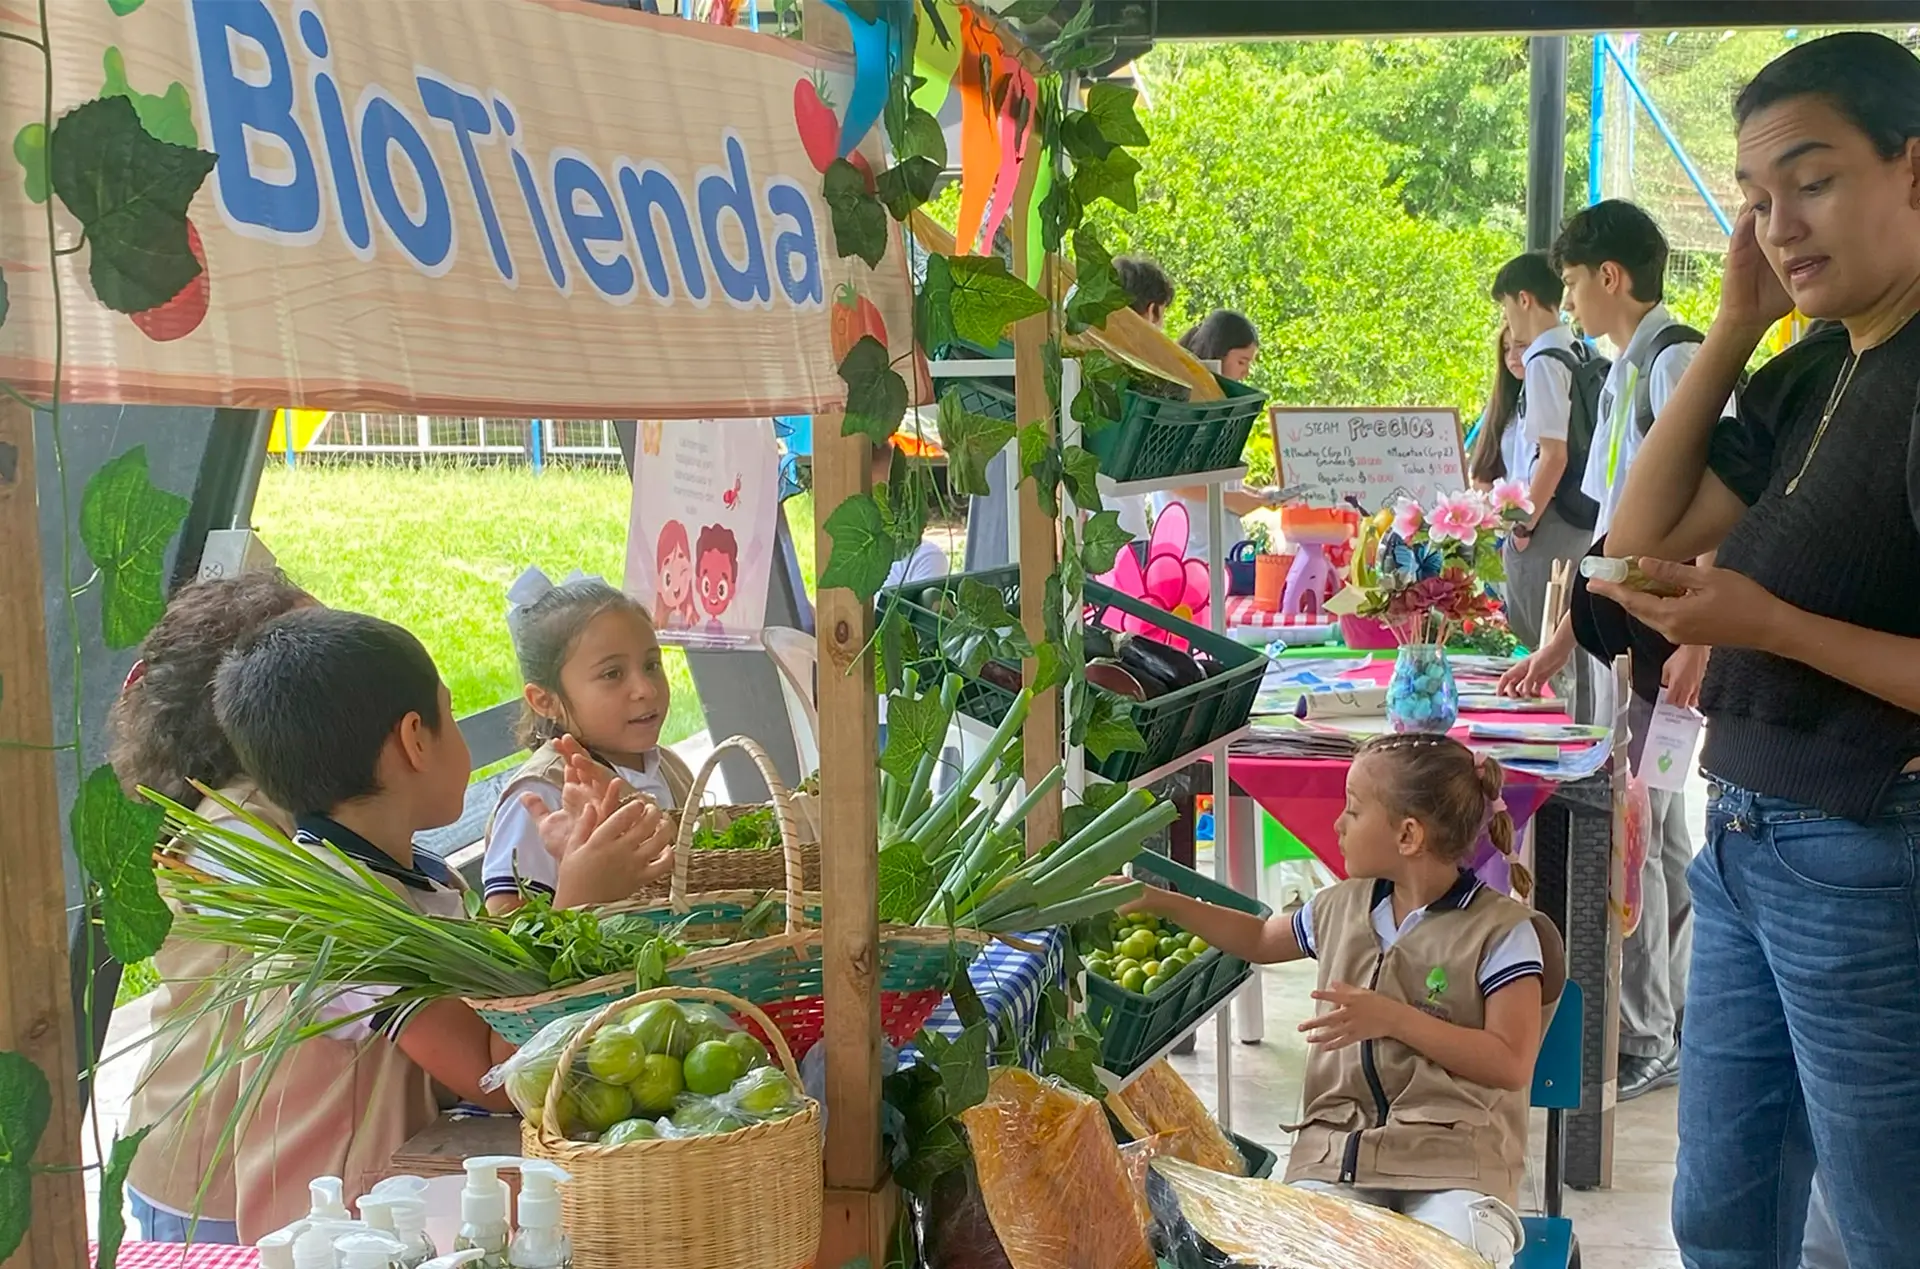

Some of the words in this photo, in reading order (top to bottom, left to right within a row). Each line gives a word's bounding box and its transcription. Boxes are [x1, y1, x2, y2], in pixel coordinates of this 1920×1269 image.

[191, 0, 824, 306] BioTienda
[1304, 422, 1340, 437] STEAM
[1347, 416, 1434, 442] Precios
